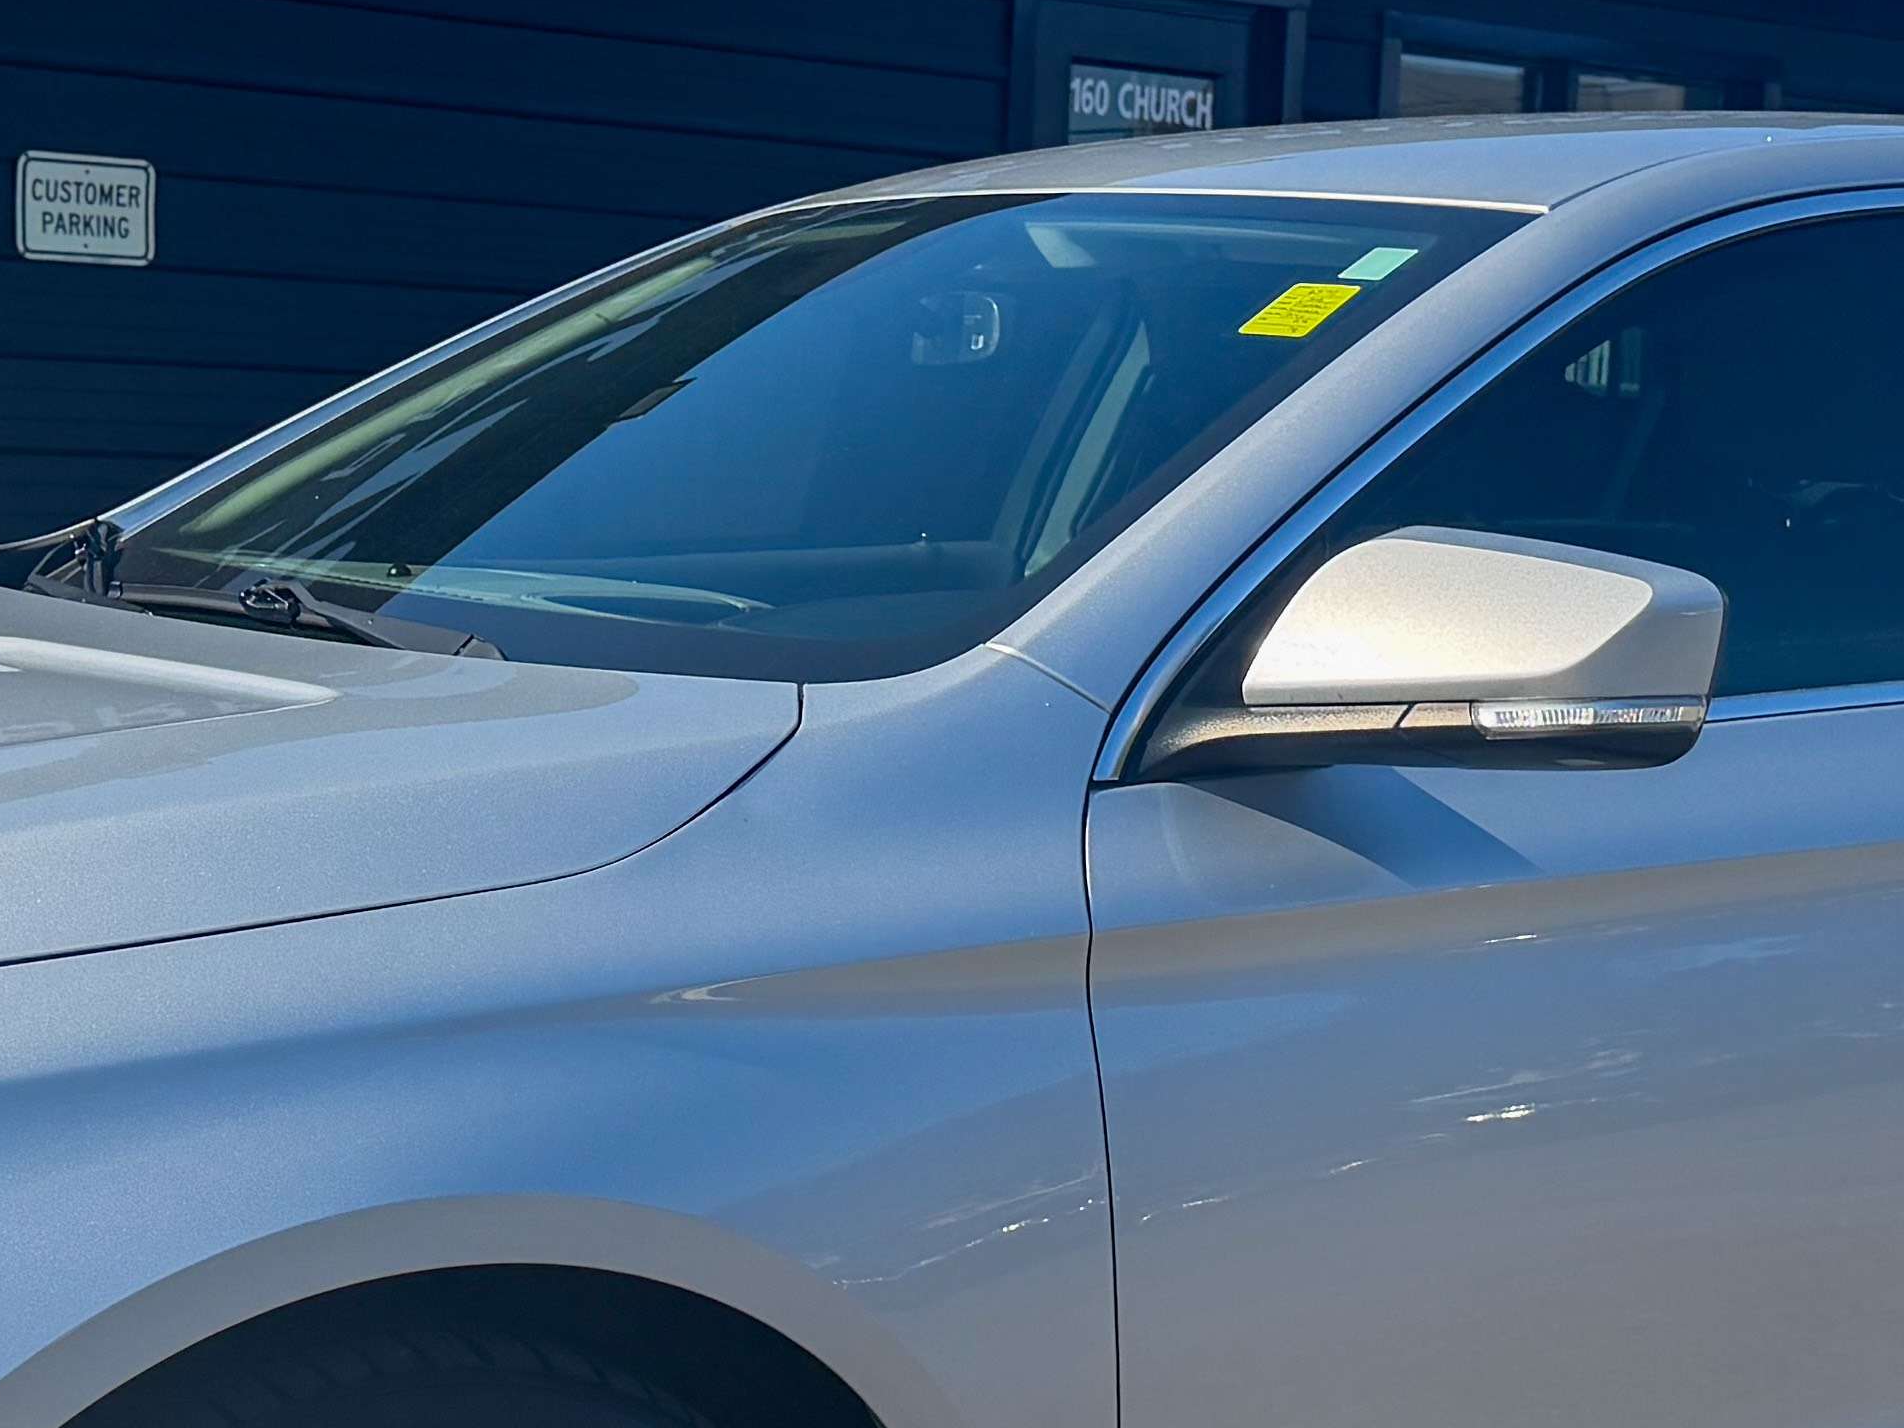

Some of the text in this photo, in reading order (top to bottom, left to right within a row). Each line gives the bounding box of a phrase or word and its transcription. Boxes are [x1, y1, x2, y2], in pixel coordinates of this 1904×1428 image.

[1069, 76, 1215, 131] 160 CHURCH
[31, 177, 142, 209] CUSTOMER
[41, 211, 130, 239] PARKING
